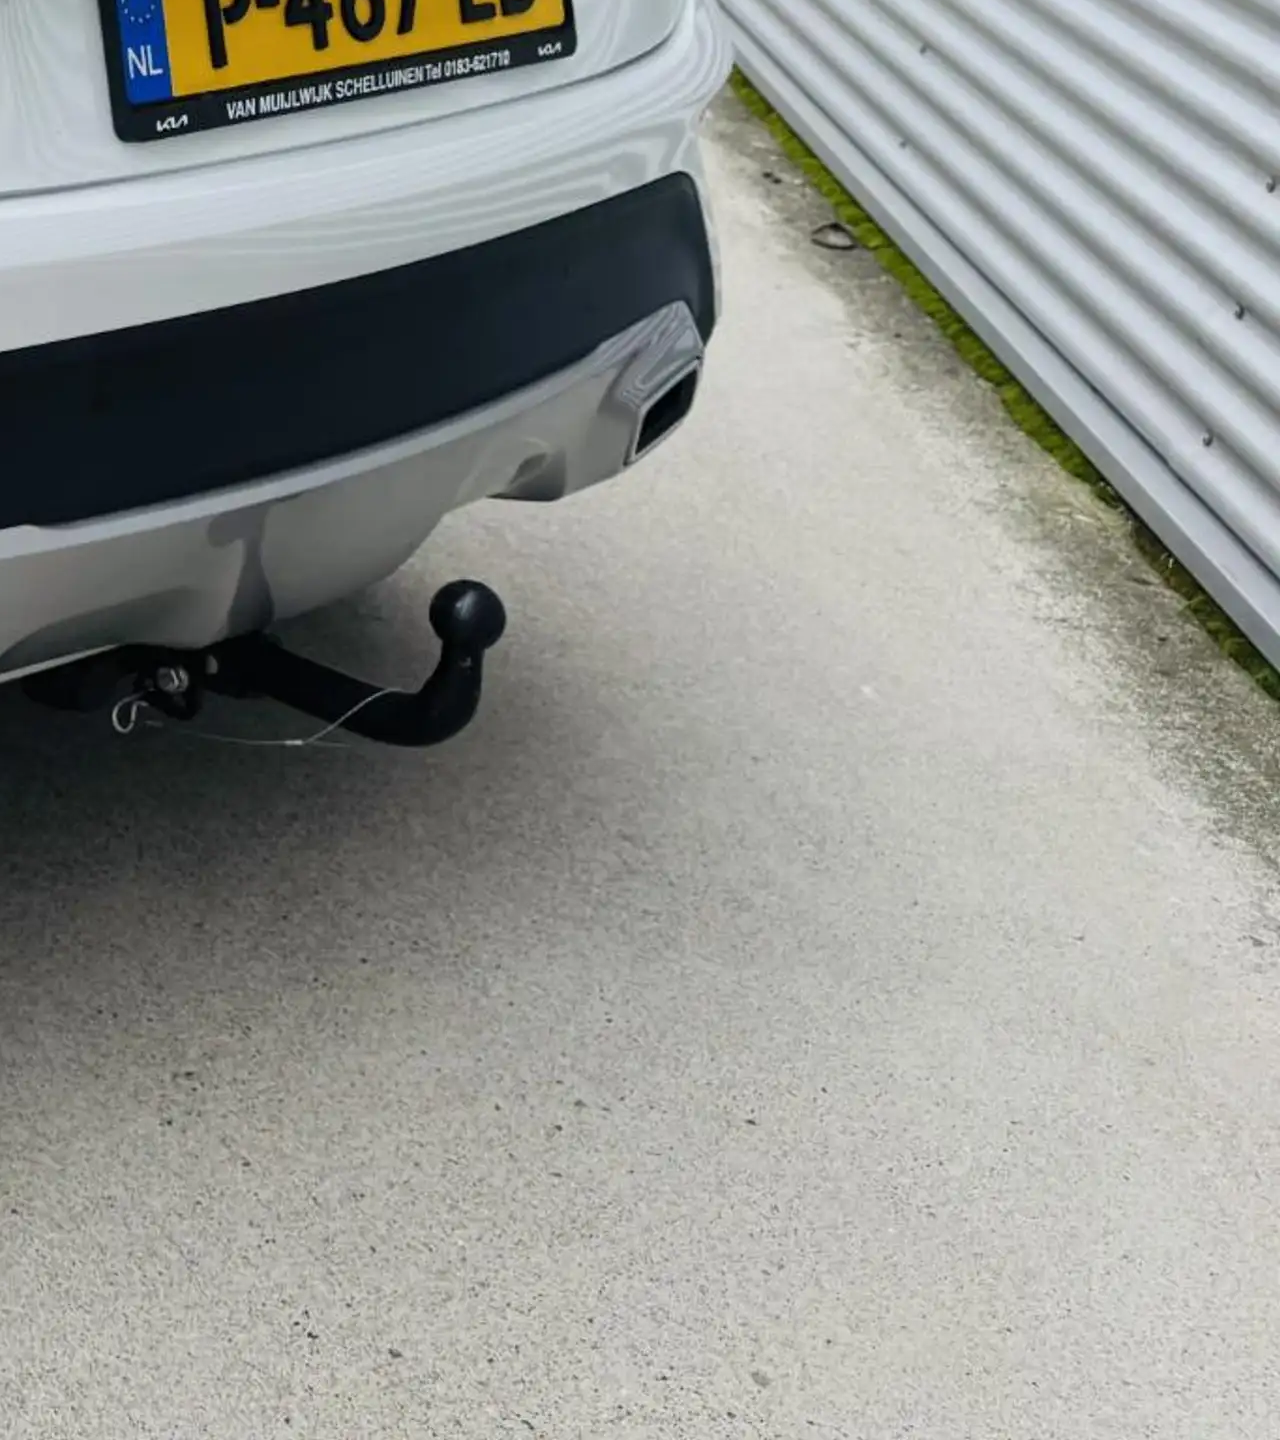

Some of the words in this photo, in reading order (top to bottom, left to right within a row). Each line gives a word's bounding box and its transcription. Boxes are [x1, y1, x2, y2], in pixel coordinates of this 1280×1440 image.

[127, 44, 164, 79] NL
[226, 97, 256, 120] VAN
[259, 83, 334, 114] MUIJLWIJK
[335, 65, 424, 98] SCHELLUINEN
[426, 62, 442, 80] Tel
[444, 50, 511, 76] 0183-621710
